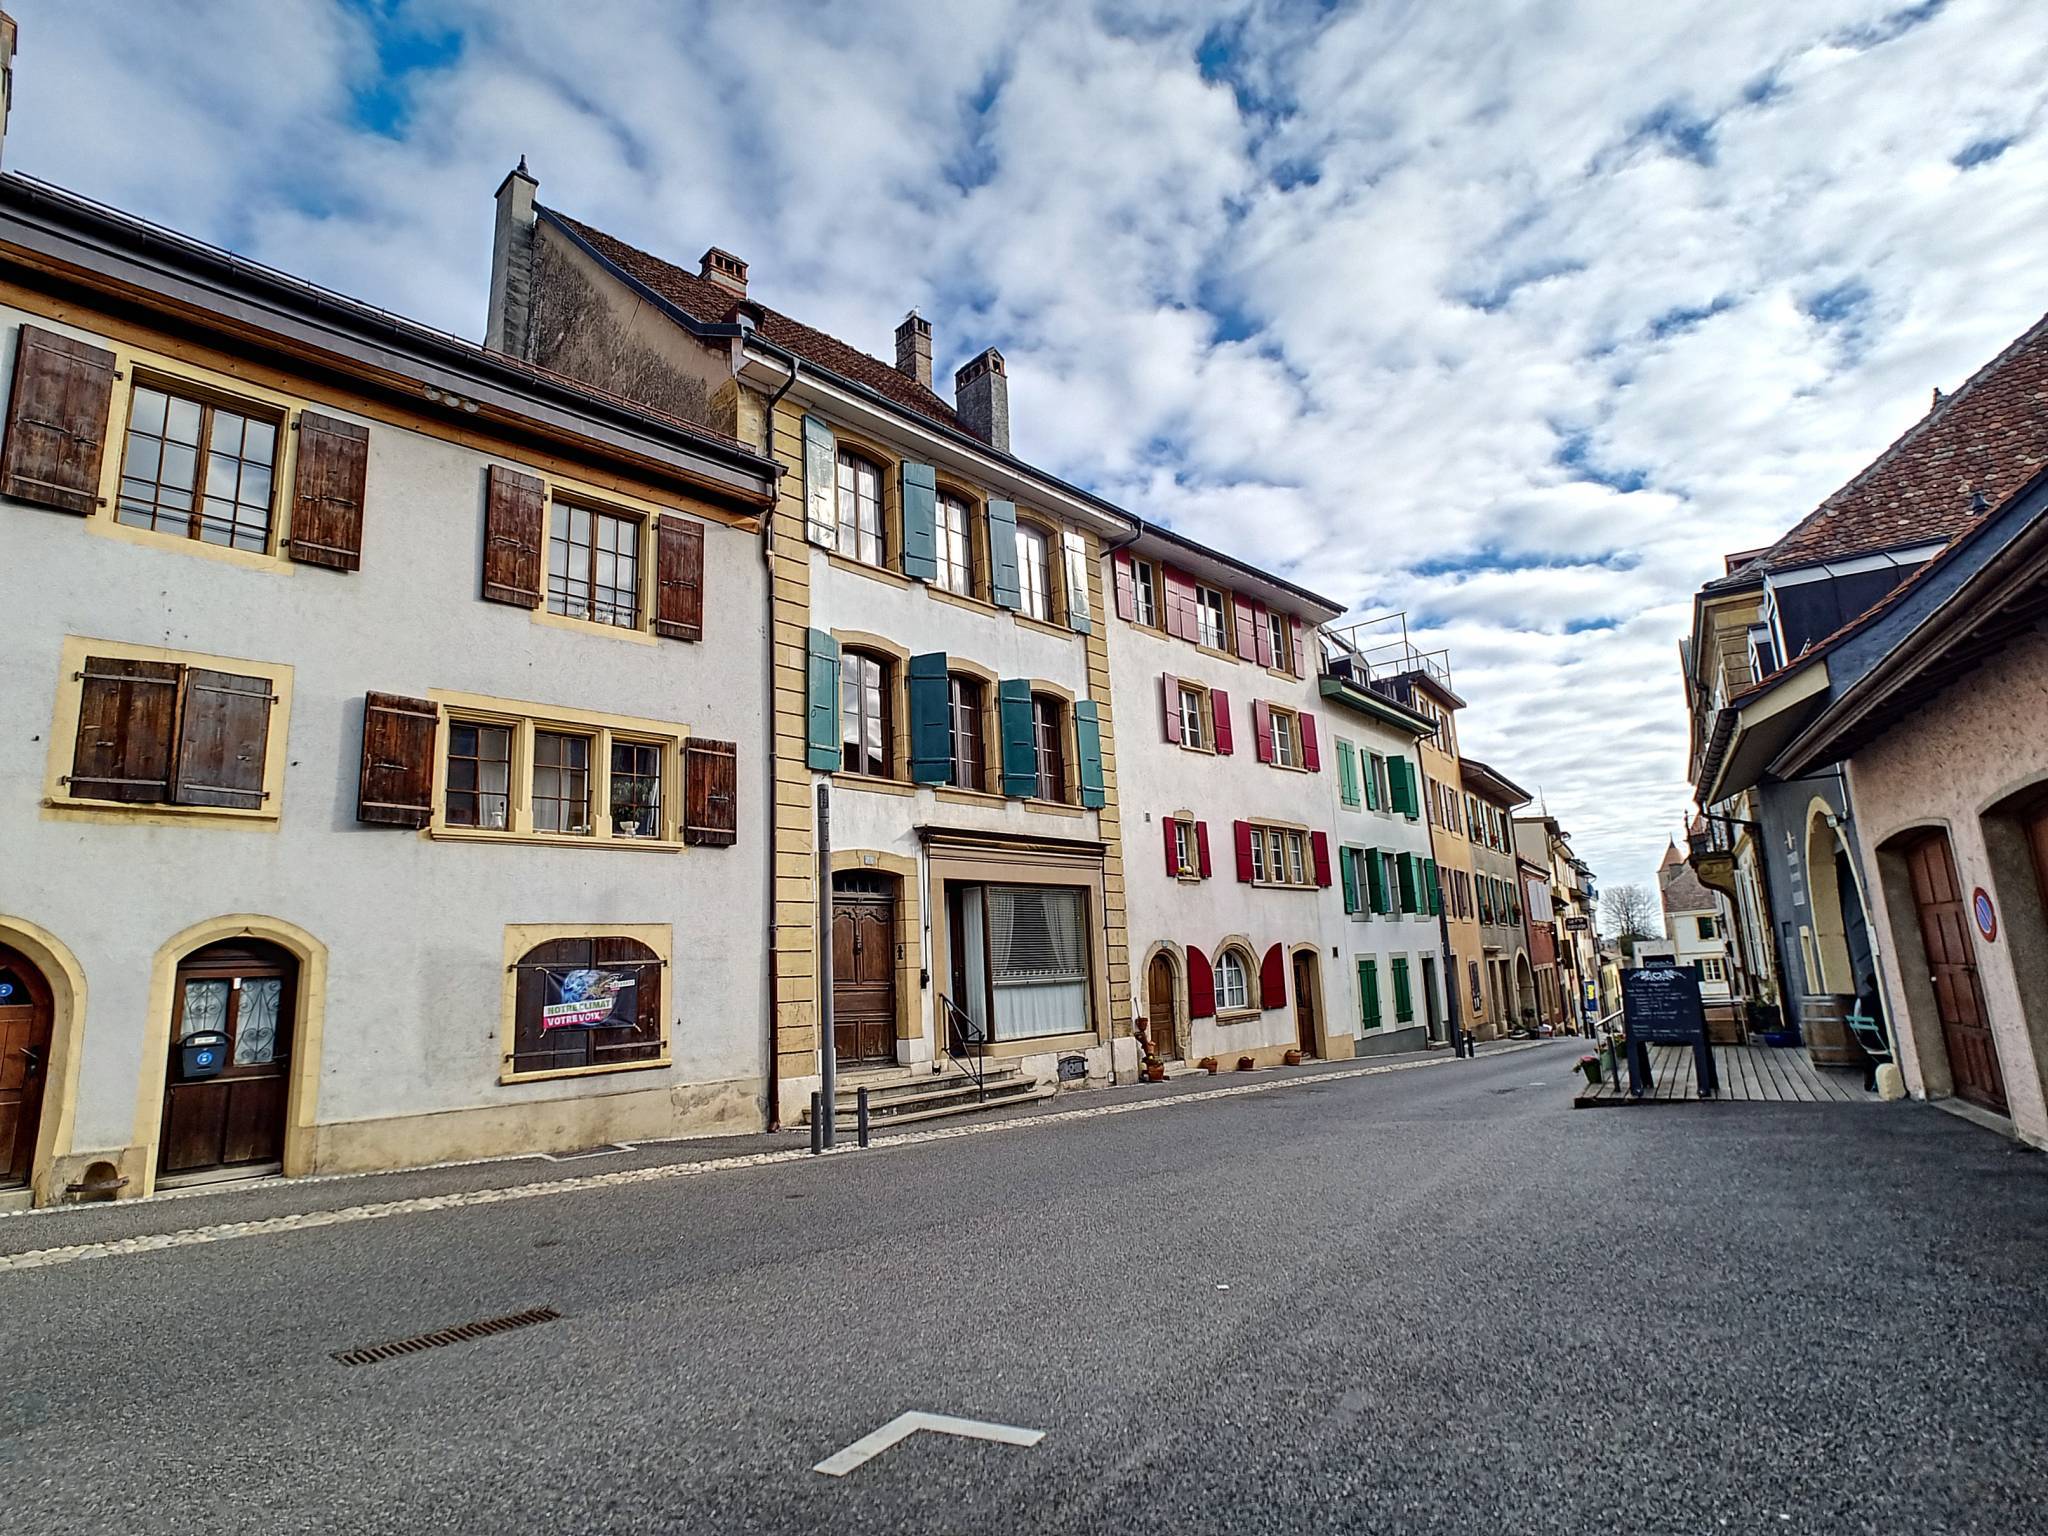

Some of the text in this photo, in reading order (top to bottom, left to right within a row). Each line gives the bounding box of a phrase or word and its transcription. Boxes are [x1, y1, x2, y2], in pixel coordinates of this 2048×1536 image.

[547, 999, 611, 1015] NOTRE CLIMAT
[547, 1012, 601, 1026] VOTRE VOIX
